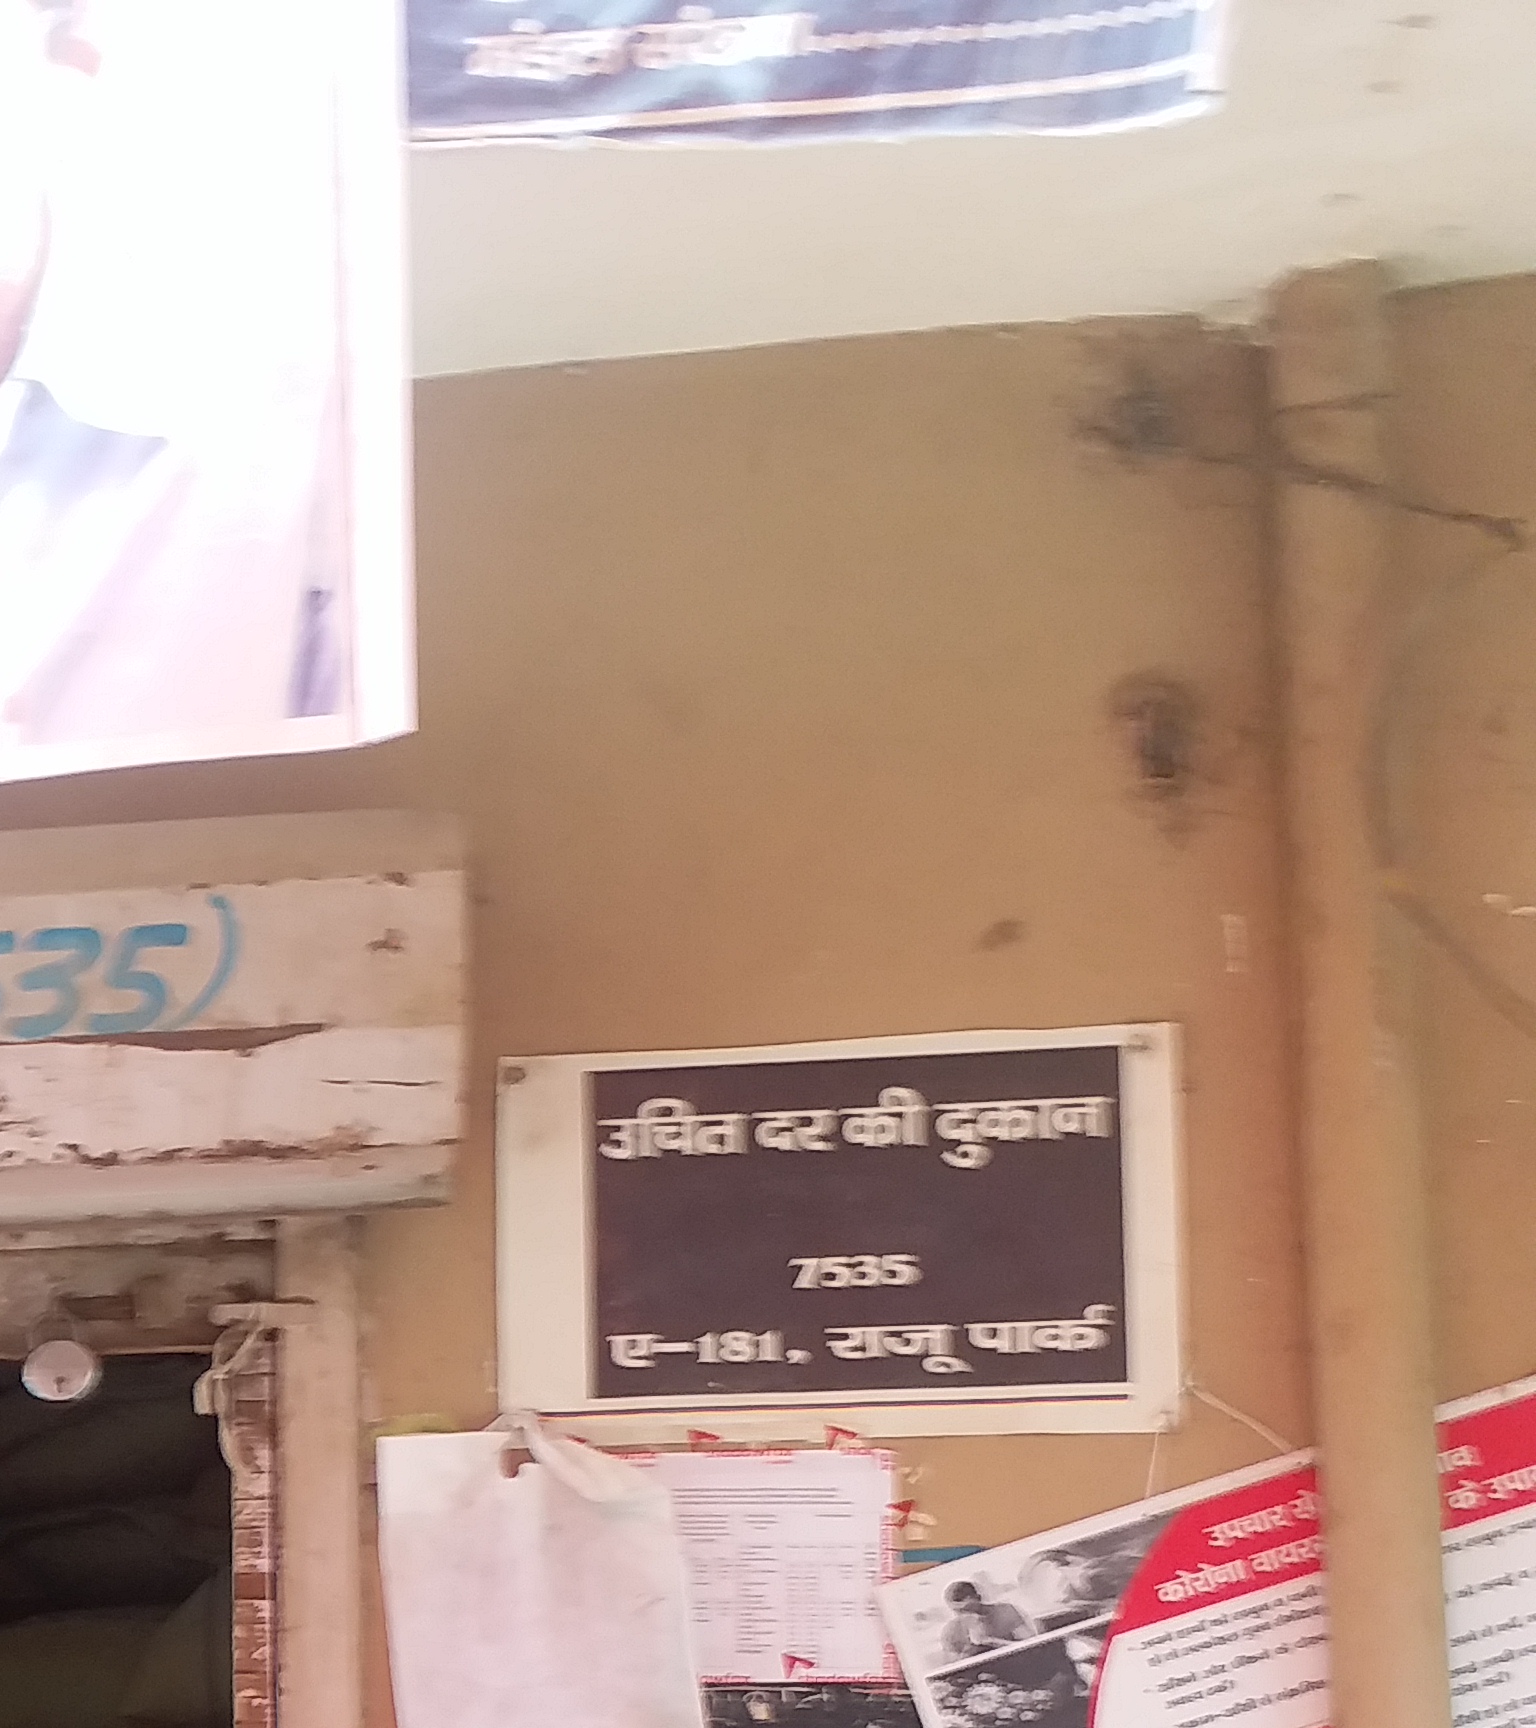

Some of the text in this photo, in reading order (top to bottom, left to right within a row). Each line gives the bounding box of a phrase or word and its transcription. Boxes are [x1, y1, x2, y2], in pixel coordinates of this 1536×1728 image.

[596, 1085, 1118, 1171] उचित दर की दुकान
[786, 1253, 926, 1291] 7535
[823, 1322, 976, 1376] राजू
[964, 1302, 1117, 1359] पार्क
[1153, 1557, 1256, 1603] कोरोना
[1247, 1533, 1324, 1575] वायर
